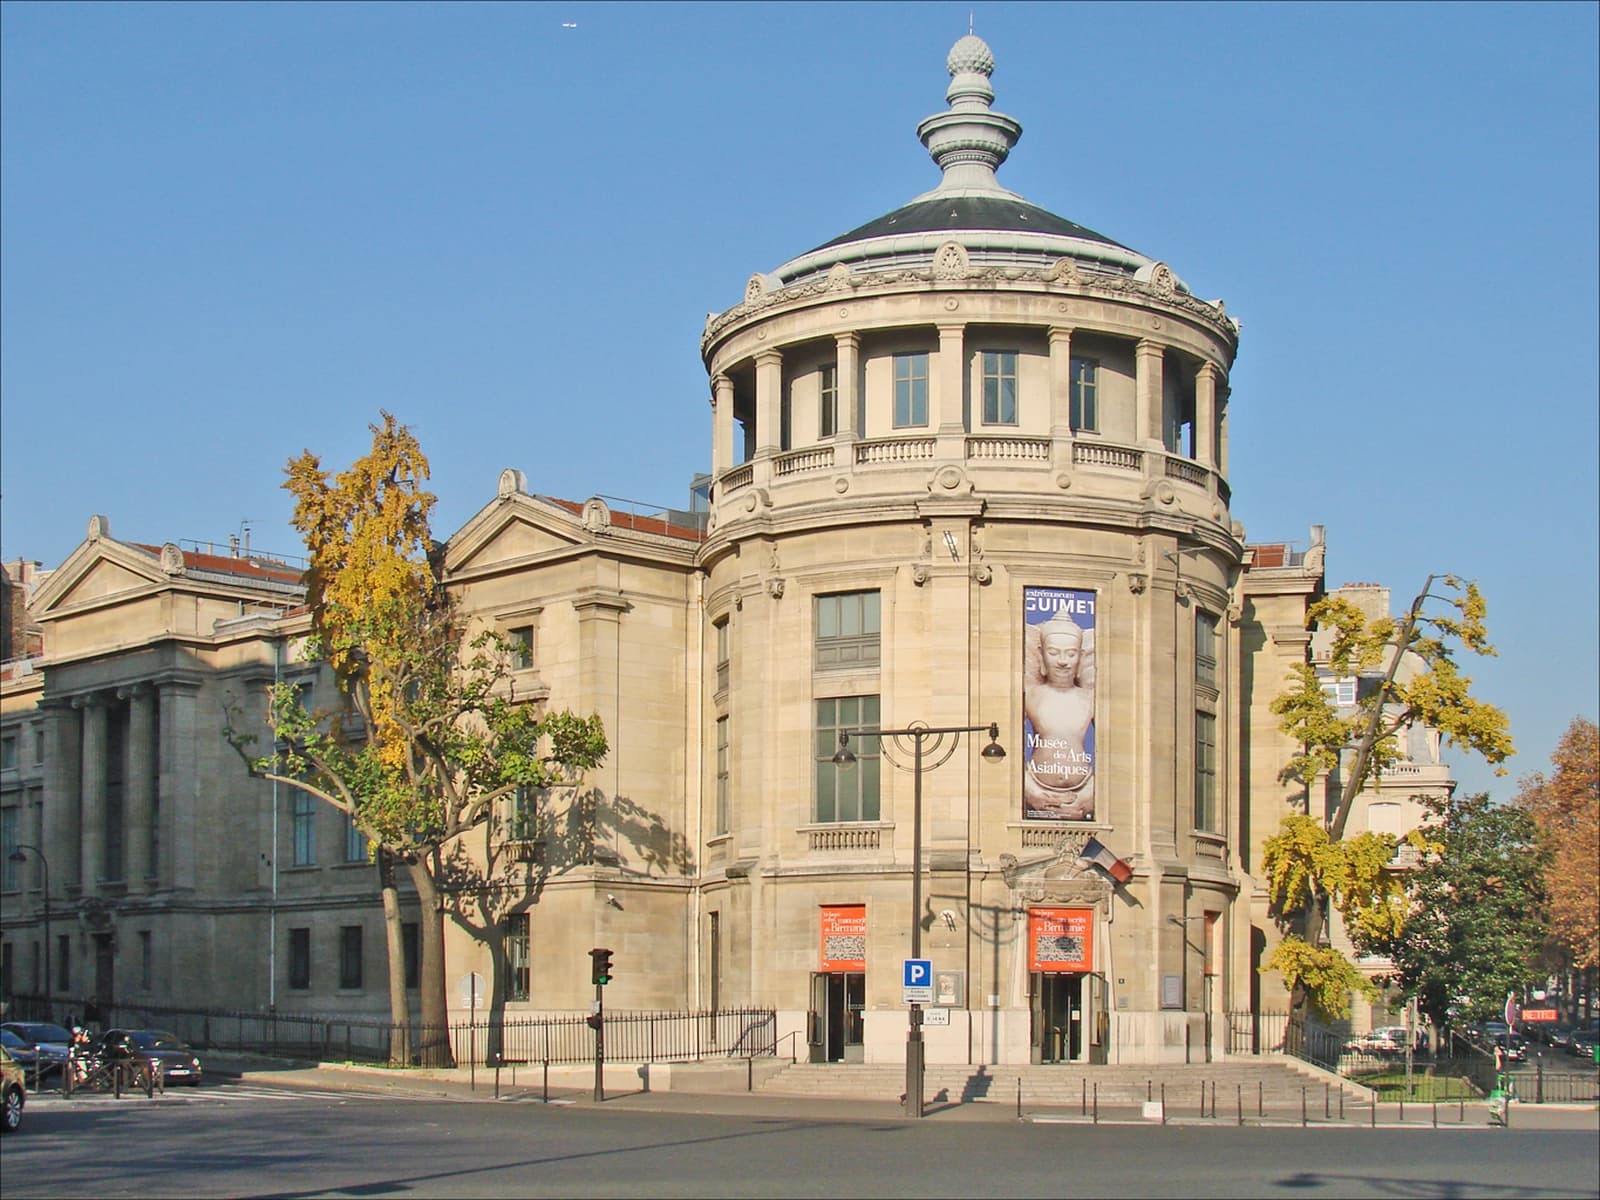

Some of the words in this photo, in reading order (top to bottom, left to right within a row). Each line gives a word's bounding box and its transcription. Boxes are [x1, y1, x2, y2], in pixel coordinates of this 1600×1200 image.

[1026, 597, 1095, 615] GUIMET
[1067, 748, 1092, 763] Arts
[1027, 759, 1089, 780] Asiatiques
[911, 965, 925, 983] P
